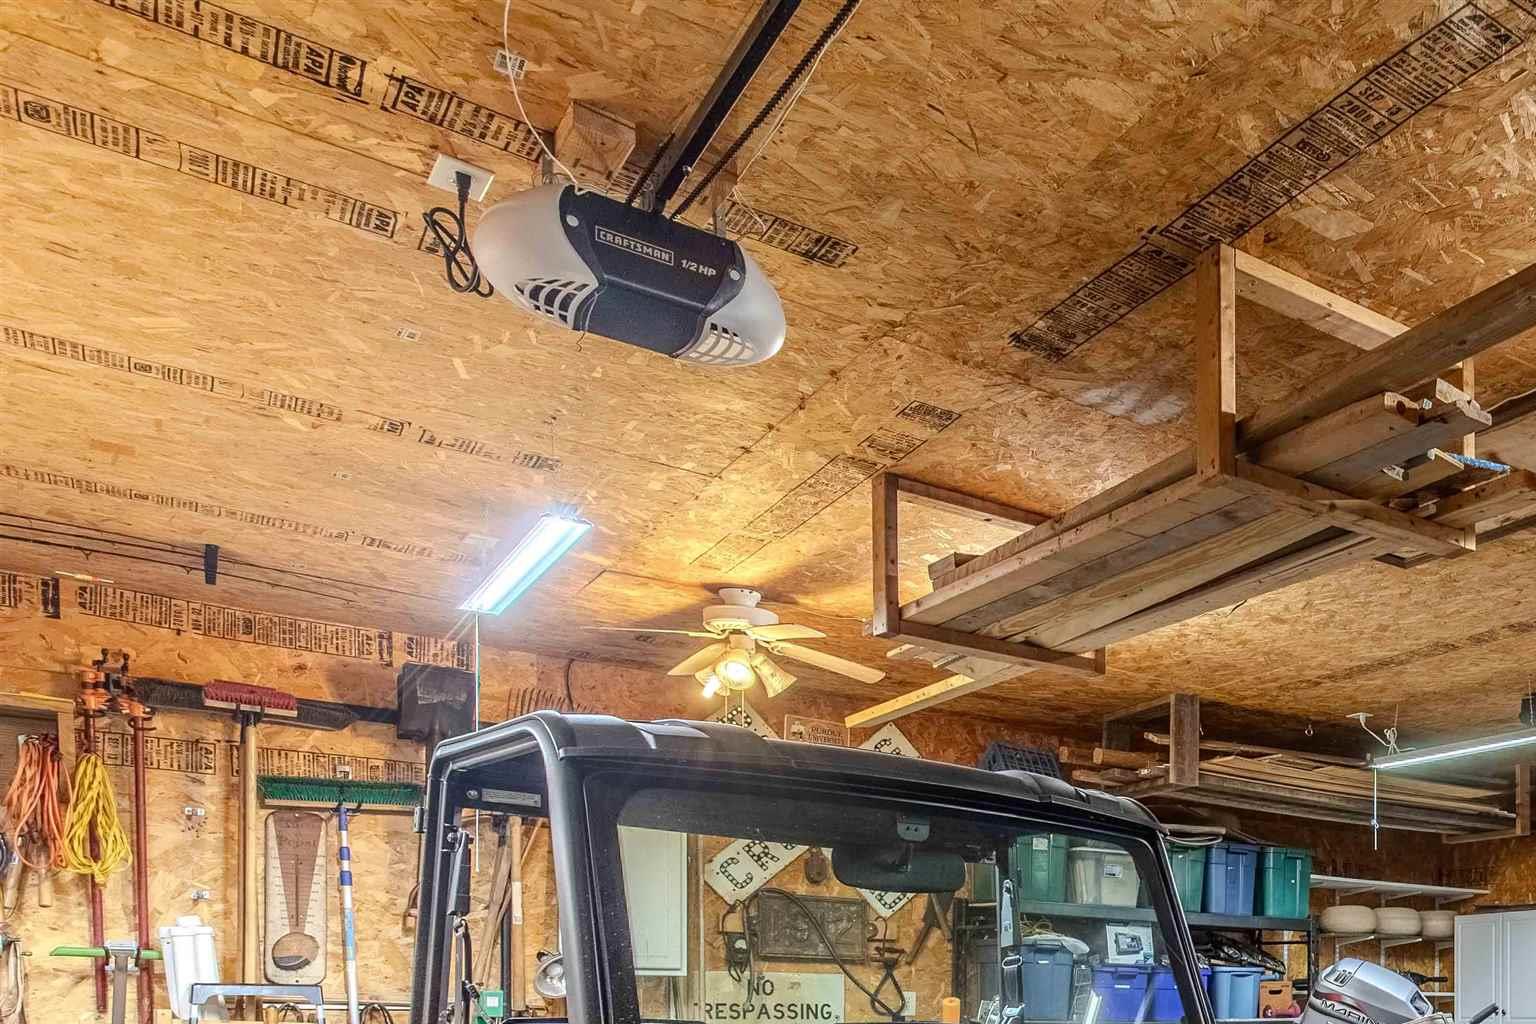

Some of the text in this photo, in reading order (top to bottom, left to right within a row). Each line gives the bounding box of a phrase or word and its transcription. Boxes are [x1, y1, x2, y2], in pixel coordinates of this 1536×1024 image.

[1465, 13, 1513, 46] APA
[399, 82, 426, 113] APA
[1357, 84, 1386, 108] SEP
[371, 209, 393, 234] APA
[599, 230, 717, 277] CRAFTSMAN 1/2 HP
[747, 978, 775, 997] NO
